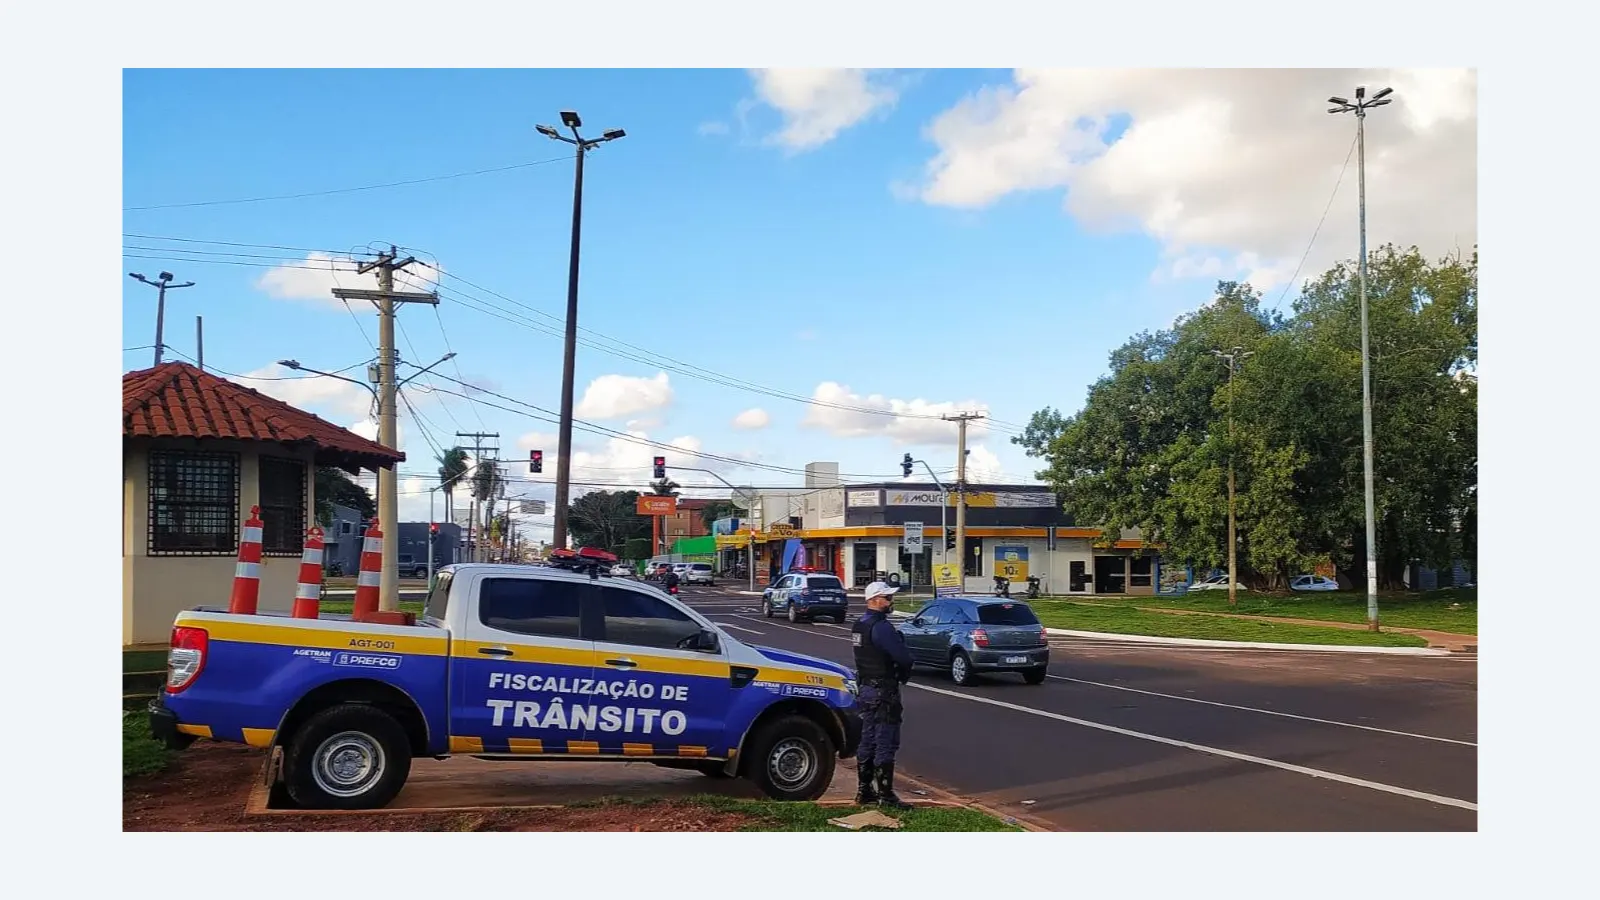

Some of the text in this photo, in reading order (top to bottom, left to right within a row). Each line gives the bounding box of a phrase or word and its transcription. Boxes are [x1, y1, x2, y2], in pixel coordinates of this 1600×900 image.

[348, 638, 396, 650] AGT-001
[293, 649, 332, 658] AGETRAN
[350, 655, 398, 667] PREFCG
[489, 672, 690, 701] FISCALIZAÇÃO DE
[793, 686, 827, 697] PREFCG
[486, 697, 688, 736] TRÂNSITO
